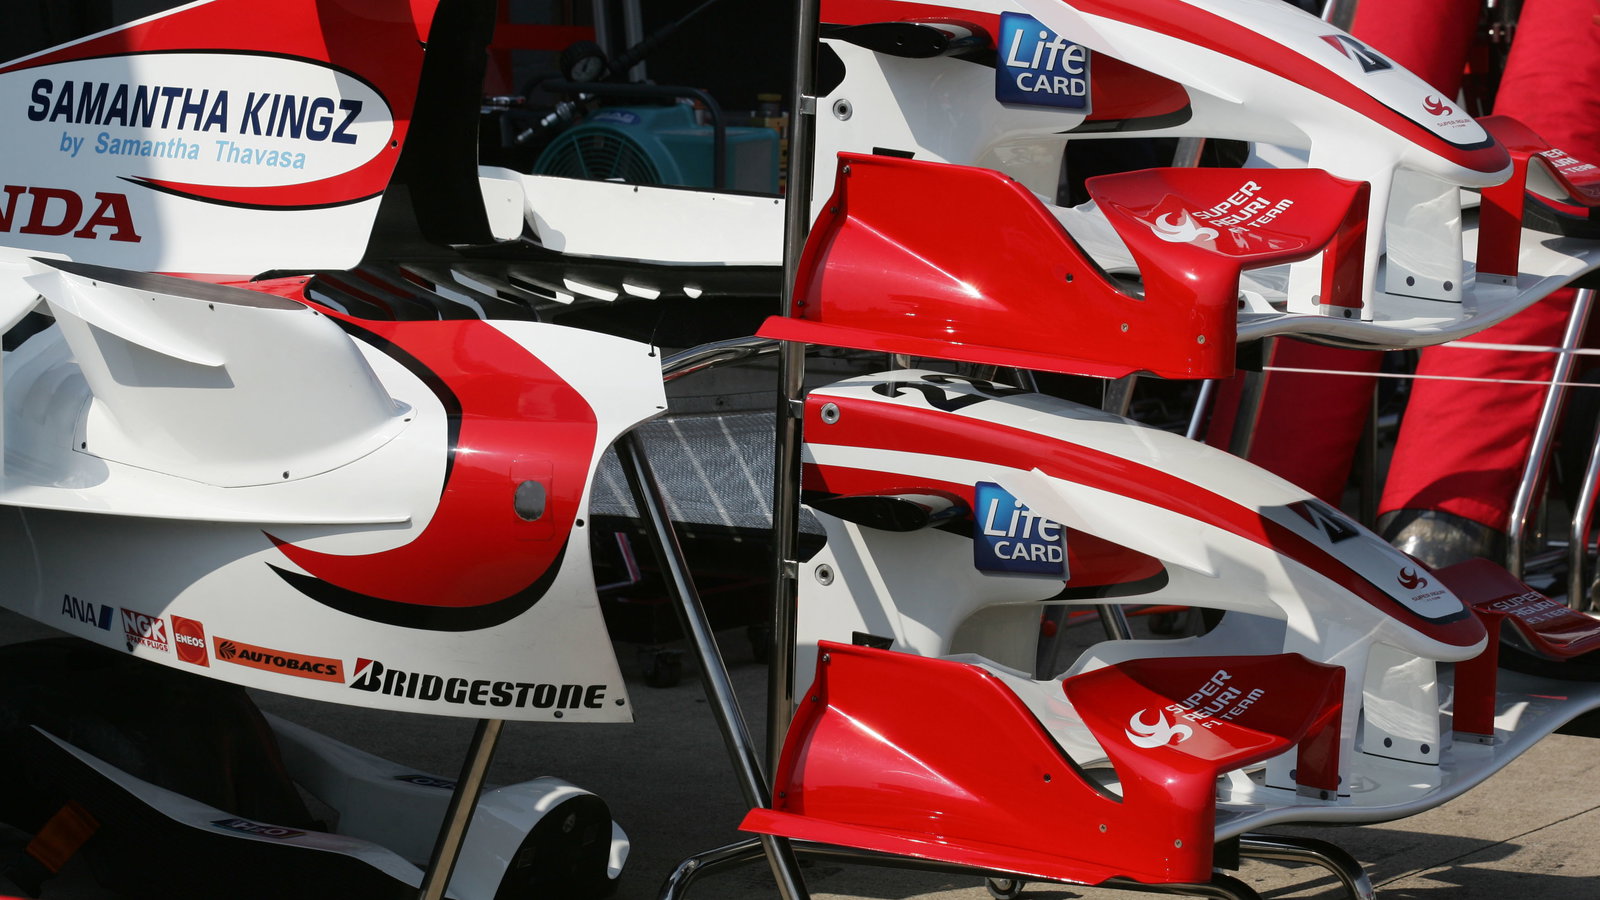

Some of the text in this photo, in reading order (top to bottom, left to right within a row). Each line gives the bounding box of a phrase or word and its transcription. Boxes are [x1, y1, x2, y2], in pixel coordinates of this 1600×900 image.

[1006, 29, 1086, 75] Life
[1016, 72, 1086, 97] CARD
[28, 78, 364, 146] SAMANTHA KINGZ
[59, 131, 307, 170] by Samantha Thavasa
[1551, 156, 1580, 168] URI
[0, 184, 142, 243] NDA
[1191, 180, 1262, 220] SUPER
[1208, 196, 1271, 228] AGURI
[1247, 198, 1294, 229] TEAM
[984, 498, 1061, 542] Life
[994, 540, 1063, 563] CARD
[61, 593, 98, 628] ANA
[1541, 606, 1571, 618] TEA
[122, 611, 165, 643] NGK
[176, 634, 204, 647] ENEOS
[146, 639, 169, 652] PLUGS
[239, 649, 337, 675] AUTOBACS
[349, 657, 608, 709] BRIDGESTONE
[1165, 669, 1232, 713] SUPER
[1181, 685, 1243, 722] AGURI
[1221, 689, 1265, 720] TEAM
